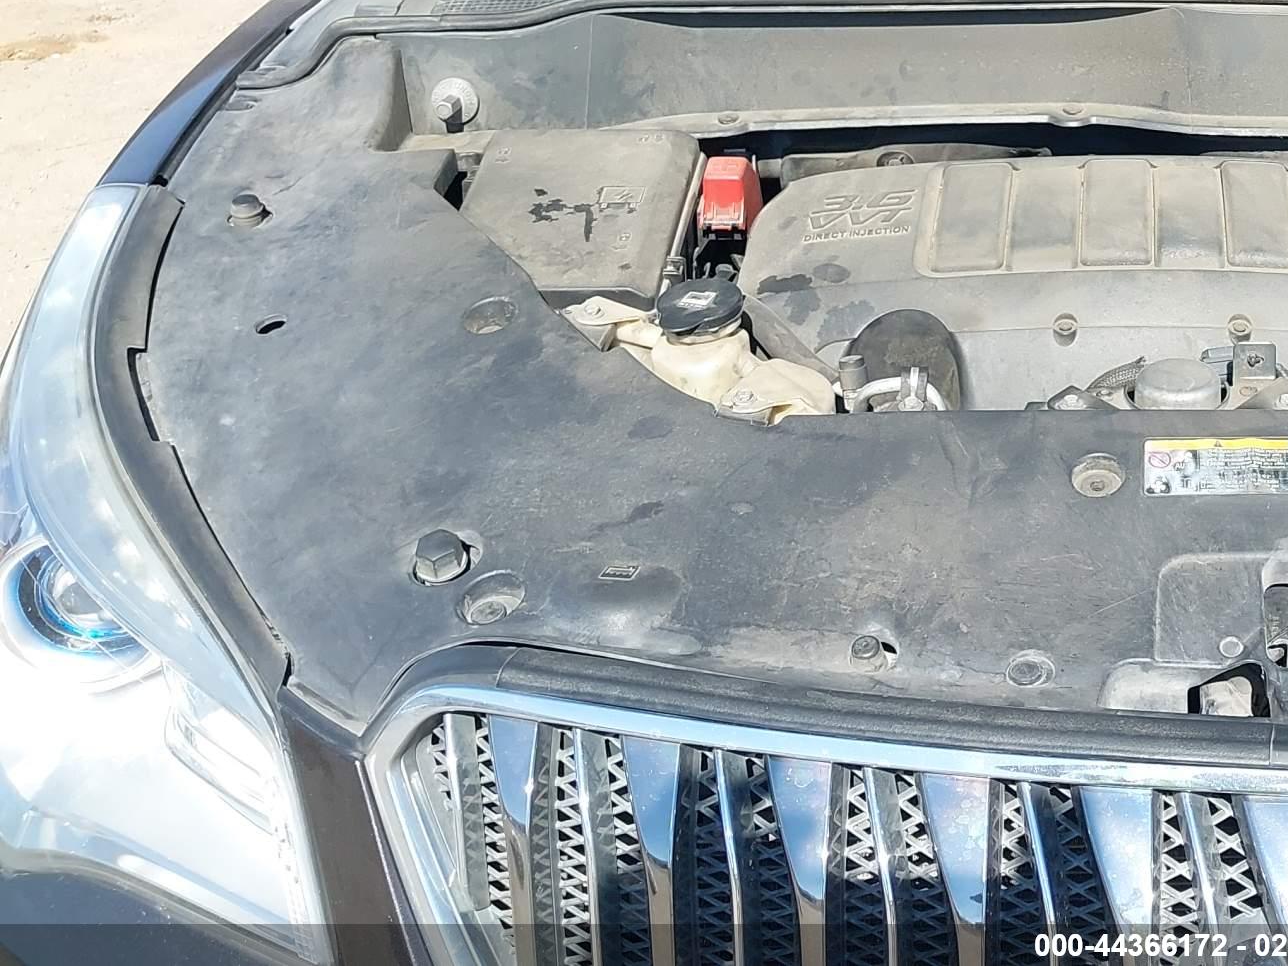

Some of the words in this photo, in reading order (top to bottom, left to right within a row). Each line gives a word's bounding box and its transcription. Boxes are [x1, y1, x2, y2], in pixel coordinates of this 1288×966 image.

[824, 189, 918, 211] 3.6
[803, 230, 847, 242] DIRECT
[849, 225, 910, 238] INJECTION
